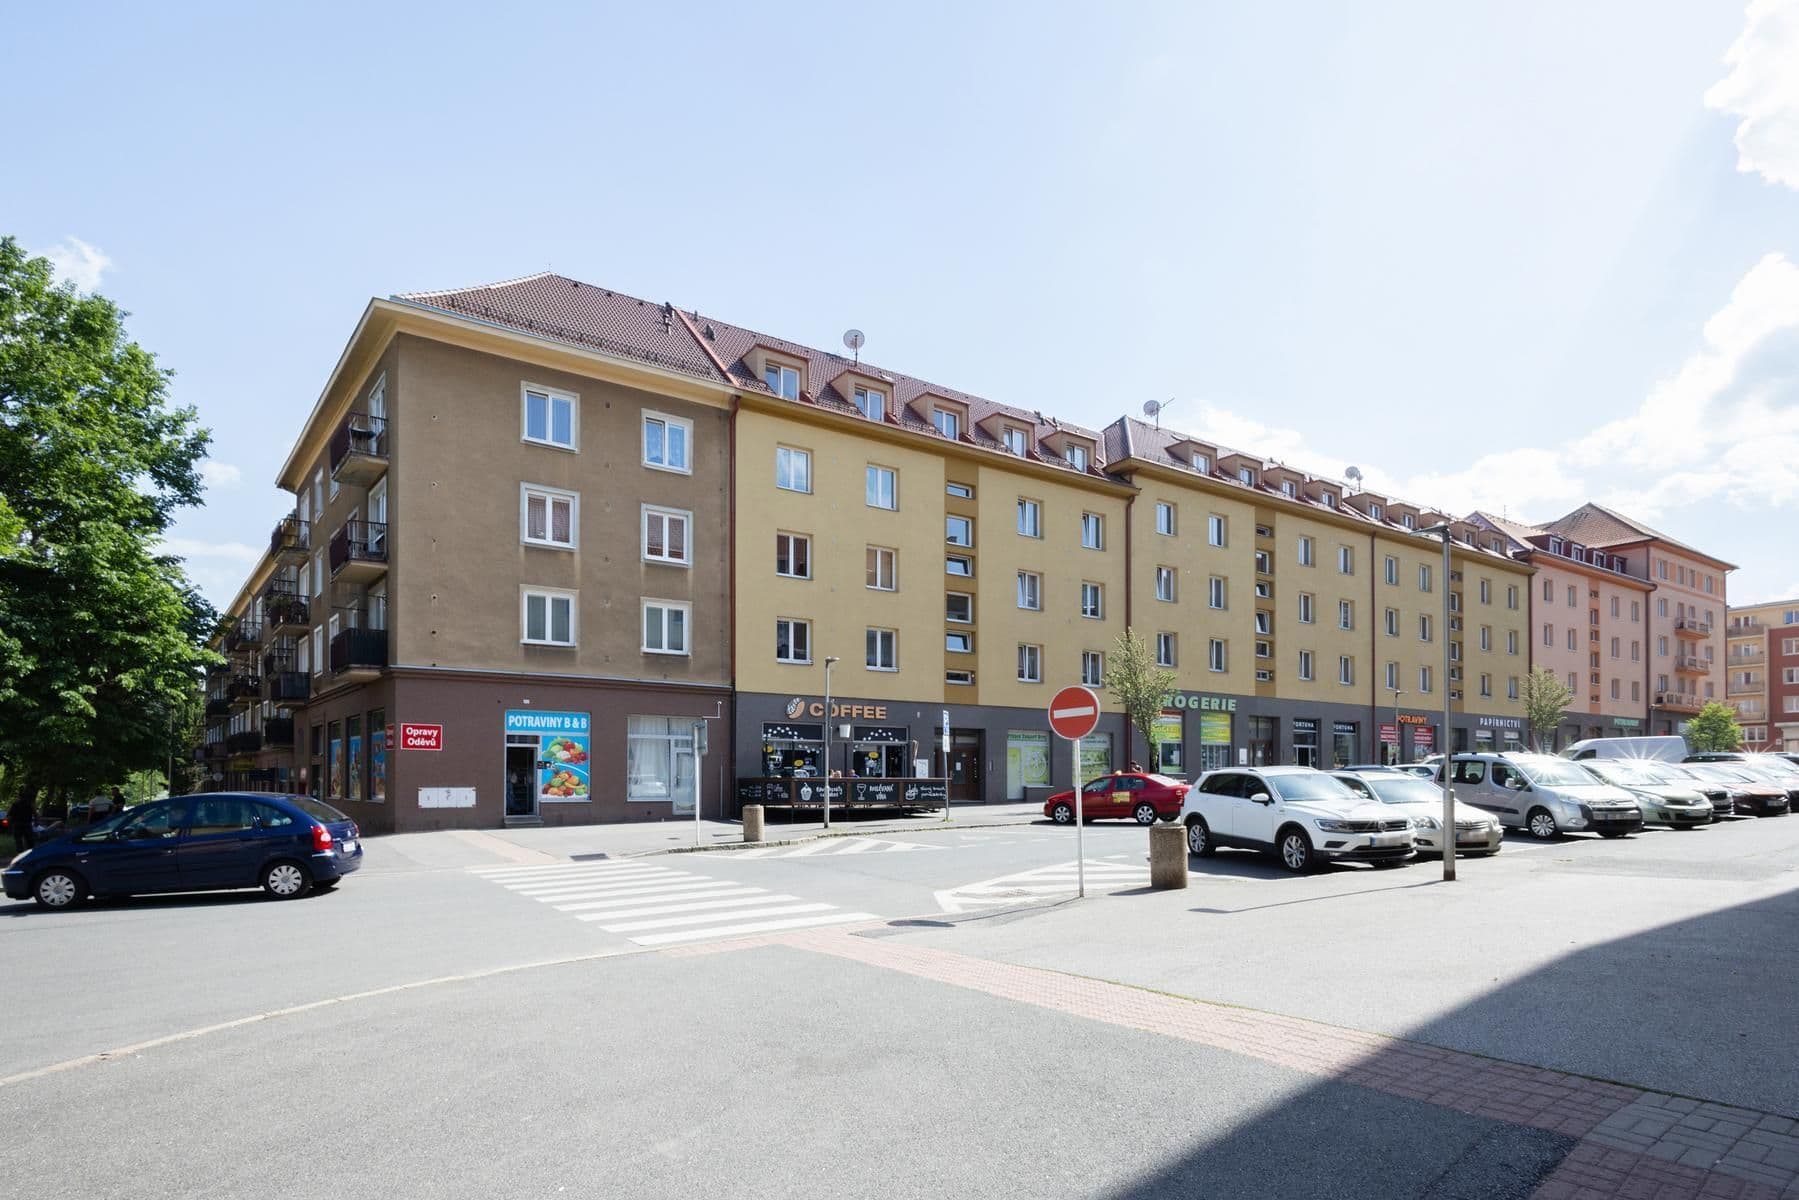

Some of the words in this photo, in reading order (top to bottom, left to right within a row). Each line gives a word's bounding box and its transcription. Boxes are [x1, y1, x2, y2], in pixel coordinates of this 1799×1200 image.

[809, 702, 887, 719] COFFEE
[1161, 696, 1238, 712] ROGERIE
[508, 715, 563, 728] POTRAVINY
[564, 718, 571, 729] B
[572, 718, 579, 729] &
[580, 719, 588, 730] B
[406, 727, 439, 737] Opravy
[407, 738, 437, 746] Oděvů
